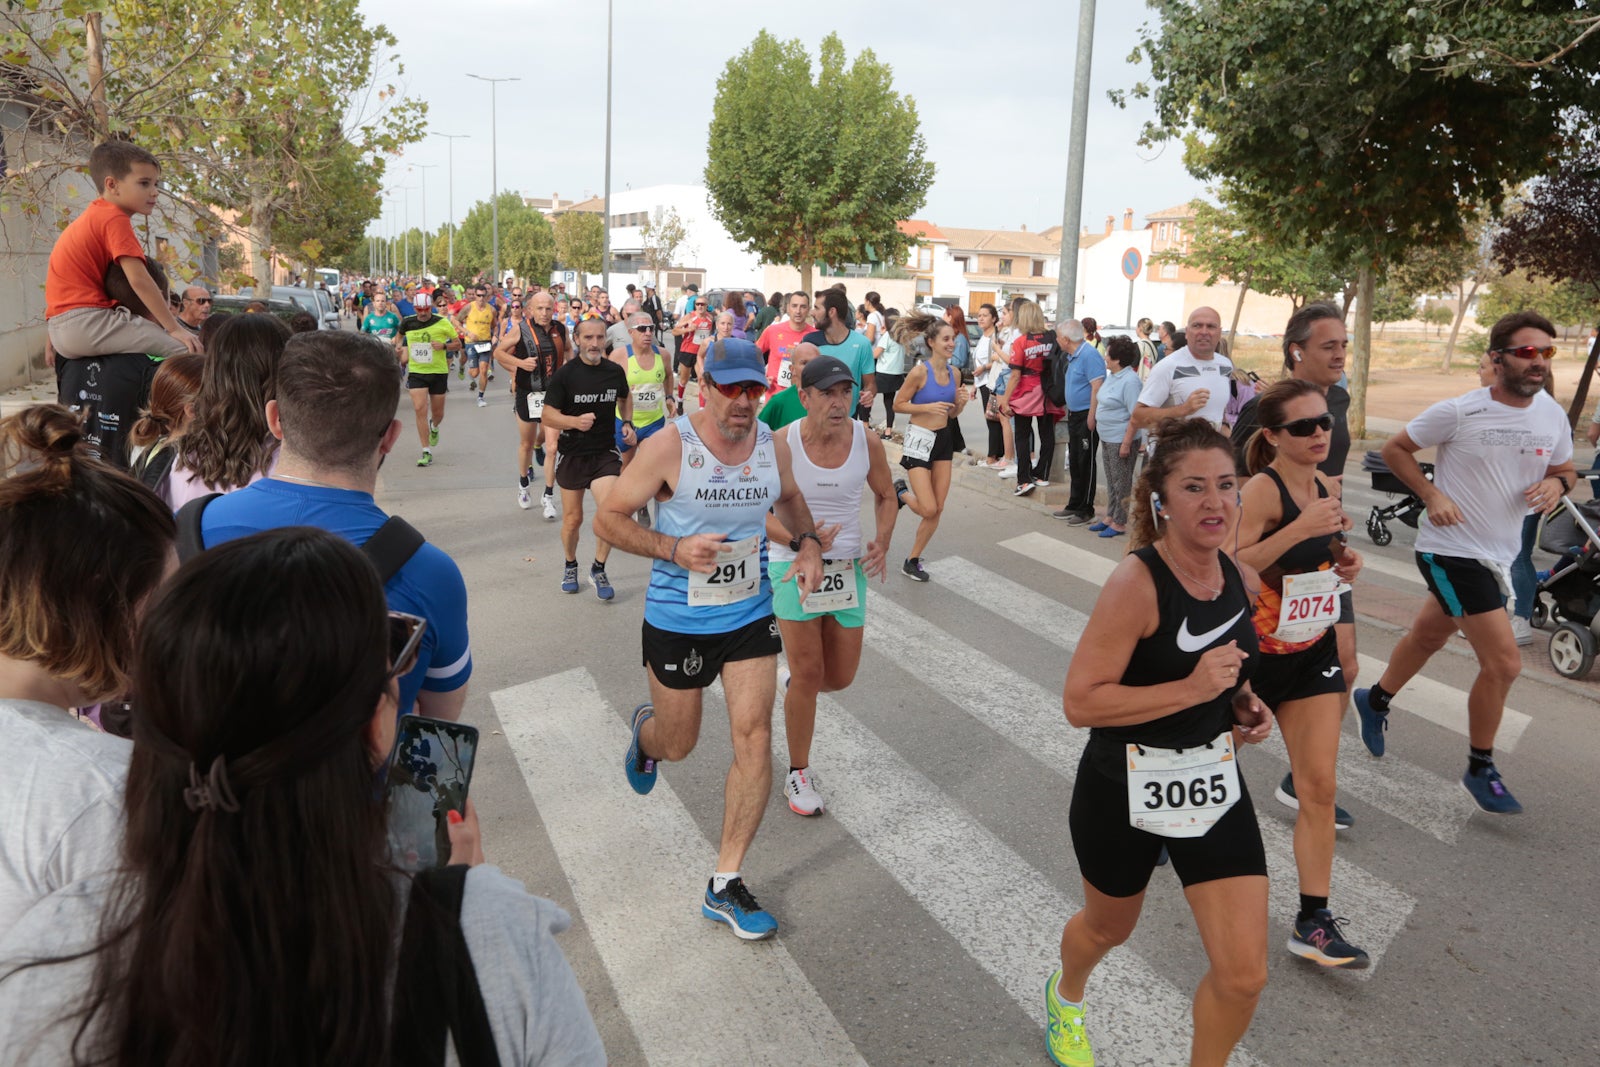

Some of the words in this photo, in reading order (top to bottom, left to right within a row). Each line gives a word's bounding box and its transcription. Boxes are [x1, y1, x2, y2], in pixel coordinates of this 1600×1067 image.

[415, 349, 428, 357] 369
[574, 393, 599, 403] BODY
[600, 393, 617, 403] LINE
[638, 392, 656, 401] 526
[695, 486, 769, 501] MARACENA
[706, 559, 746, 584] 291
[1287, 594, 1335, 621] 2074
[1143, 773, 1228, 810] 3065
